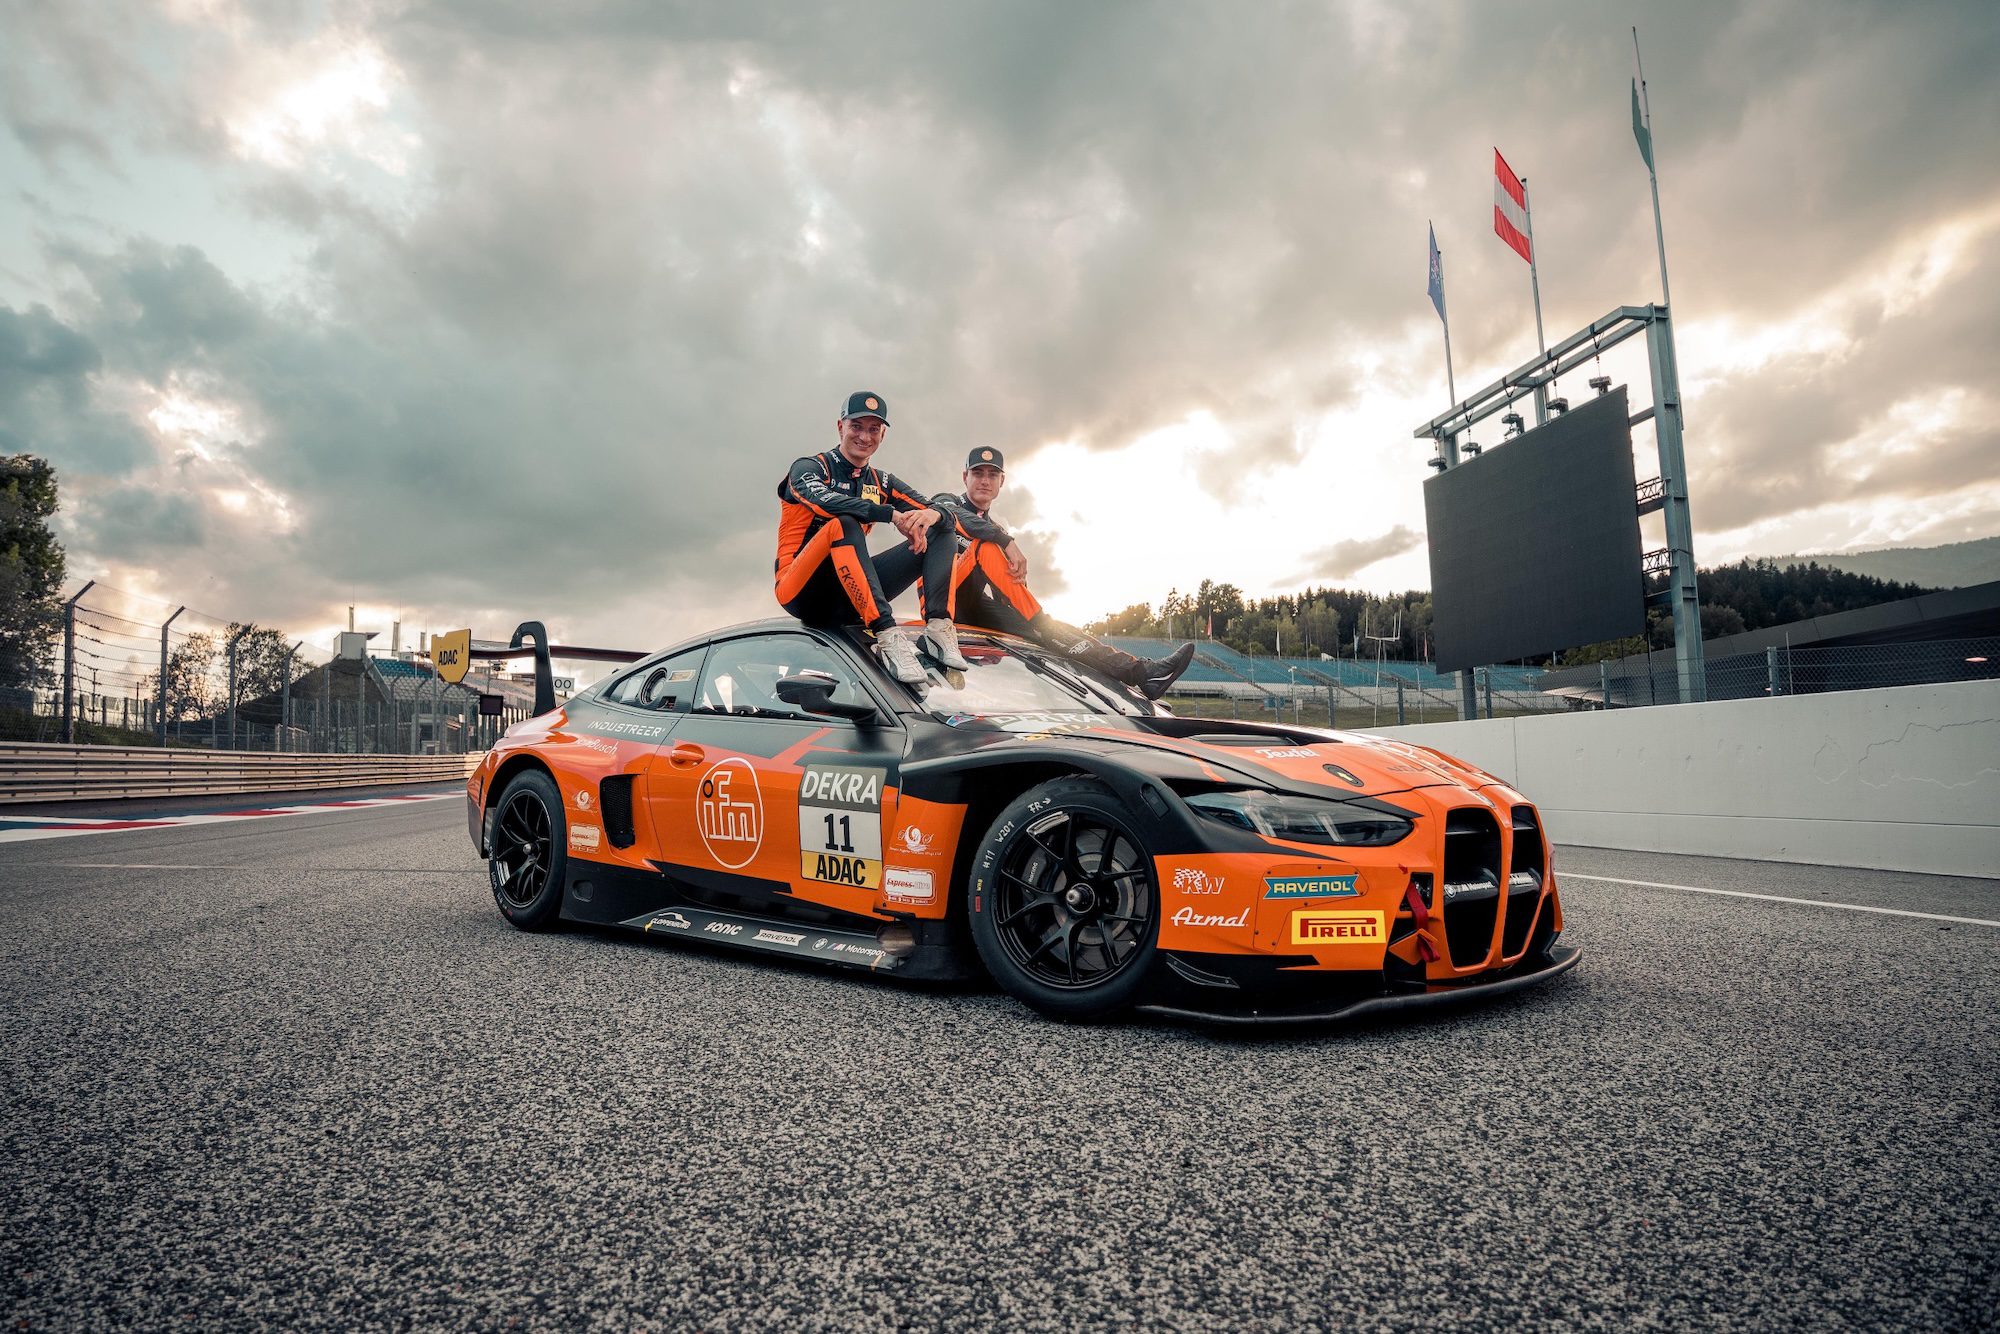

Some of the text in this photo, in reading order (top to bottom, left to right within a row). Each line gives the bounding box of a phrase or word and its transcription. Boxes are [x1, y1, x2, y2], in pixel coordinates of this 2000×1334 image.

[438, 649, 458, 666] ADAC
[587, 720, 662, 737] INDUSTREER
[802, 771, 879, 805] DEKRA
[703, 771, 758, 843] ifm
[824, 813, 855, 853] 11
[815, 854, 866, 886] ADAC
[1181, 876, 1225, 895] KW
[1273, 881, 1351, 894] RAVENOL
[1170, 906, 1249, 927] Armal
[1300, 917, 1377, 938] PIRELLI
[758, 932, 798, 944] RAVENOL
[844, 944, 887, 957] Motorsport
